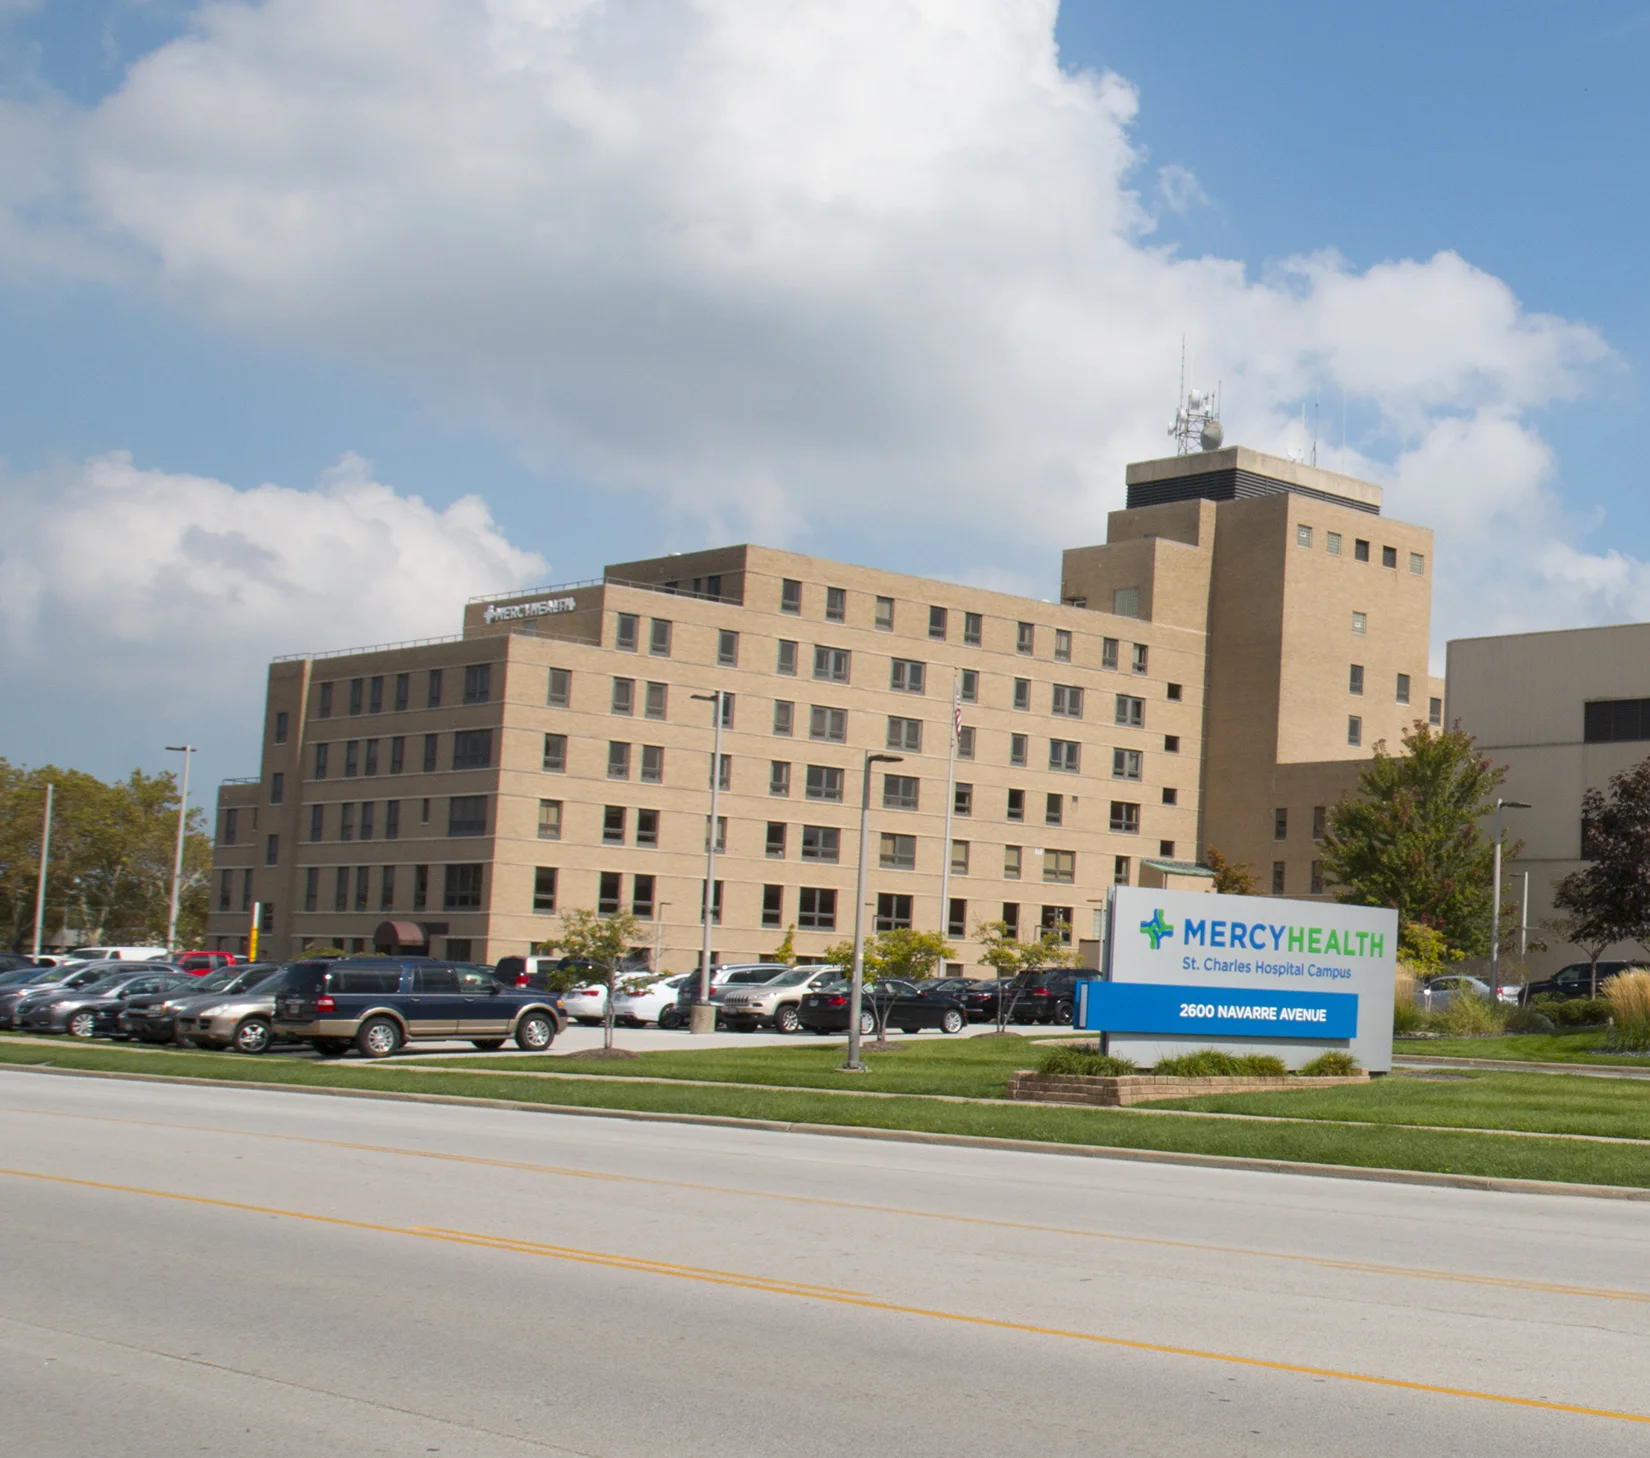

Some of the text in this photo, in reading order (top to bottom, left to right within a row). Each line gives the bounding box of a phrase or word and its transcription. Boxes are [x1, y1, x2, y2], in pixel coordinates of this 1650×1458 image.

[1183, 918, 1384, 958] MERCYHEALTH
[1182, 956, 1352, 980] St. Charles Hospital Campus
[1179, 1003, 1327, 1022] 2600 NAVARRE AVENUE
